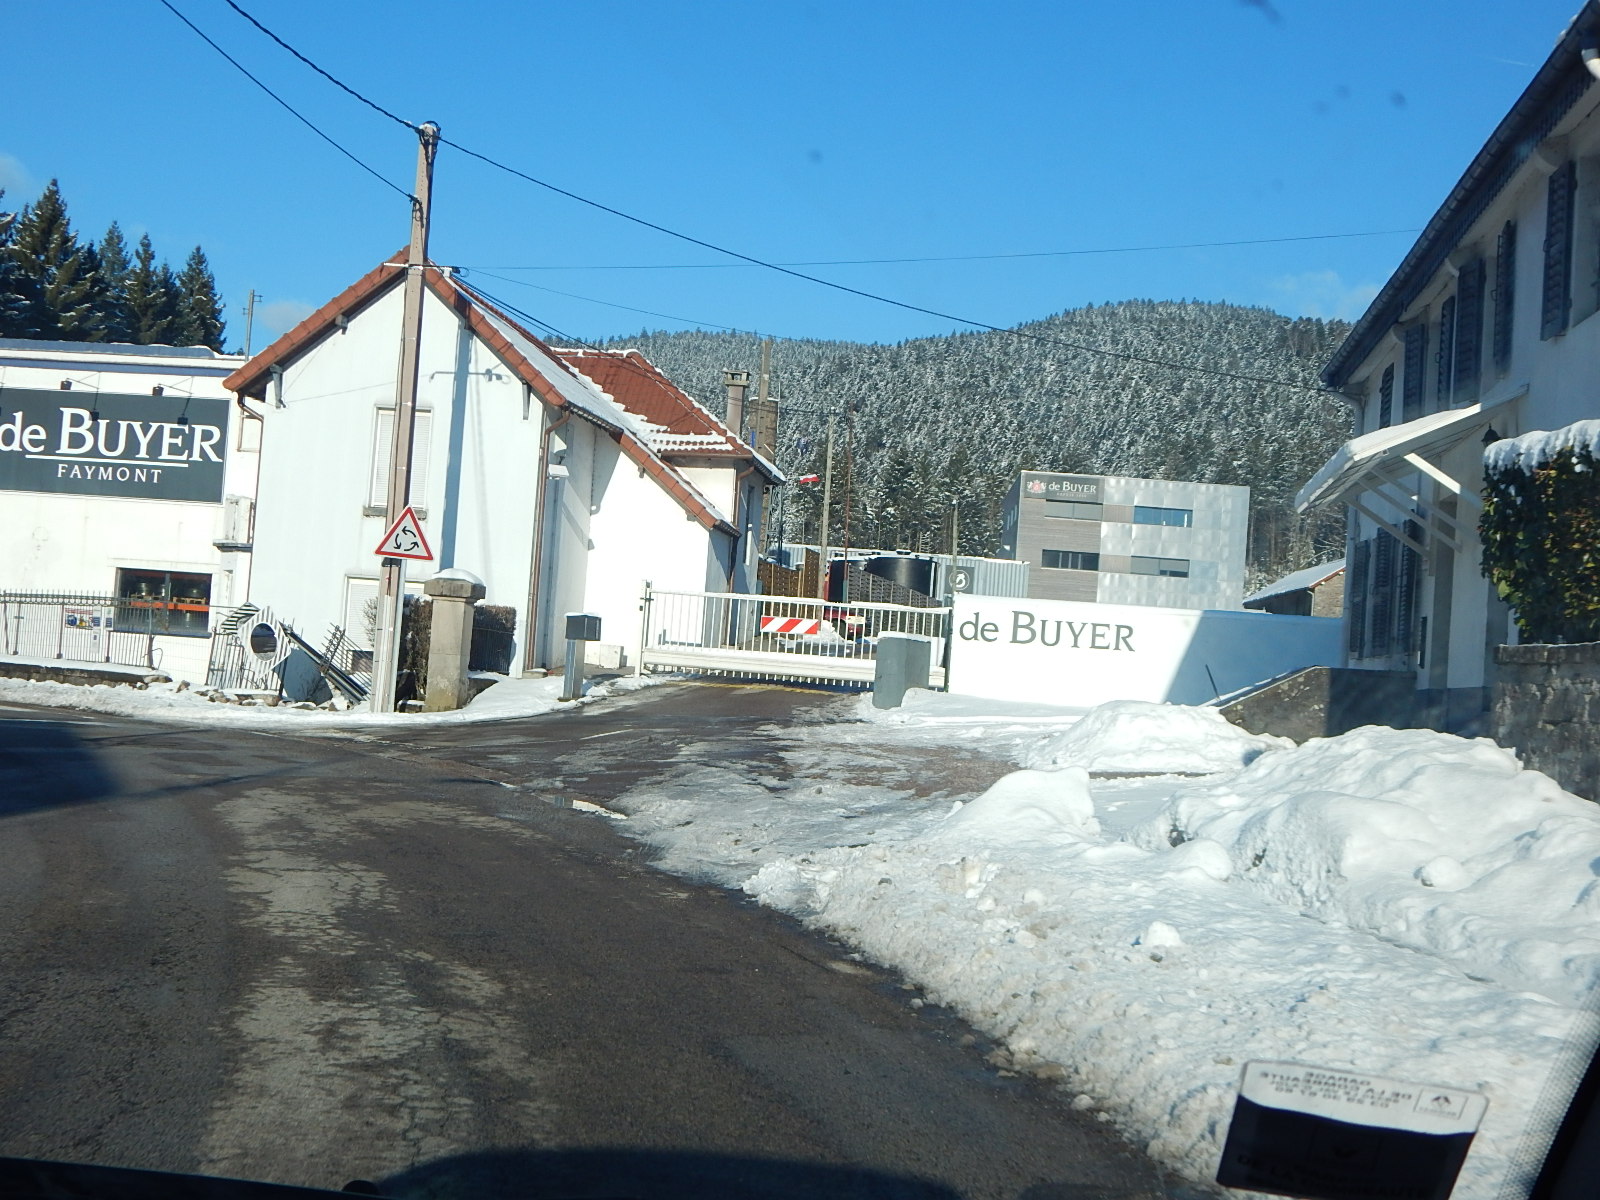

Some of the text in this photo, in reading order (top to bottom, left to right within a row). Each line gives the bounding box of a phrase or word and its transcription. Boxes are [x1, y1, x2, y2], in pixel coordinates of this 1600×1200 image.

[0, 407, 223, 463] de BUYER
[57, 463, 162, 484] FAYMONT
[1048, 481, 1097, 493] de BUYER
[959, 610, 1136, 652] de BUYER
